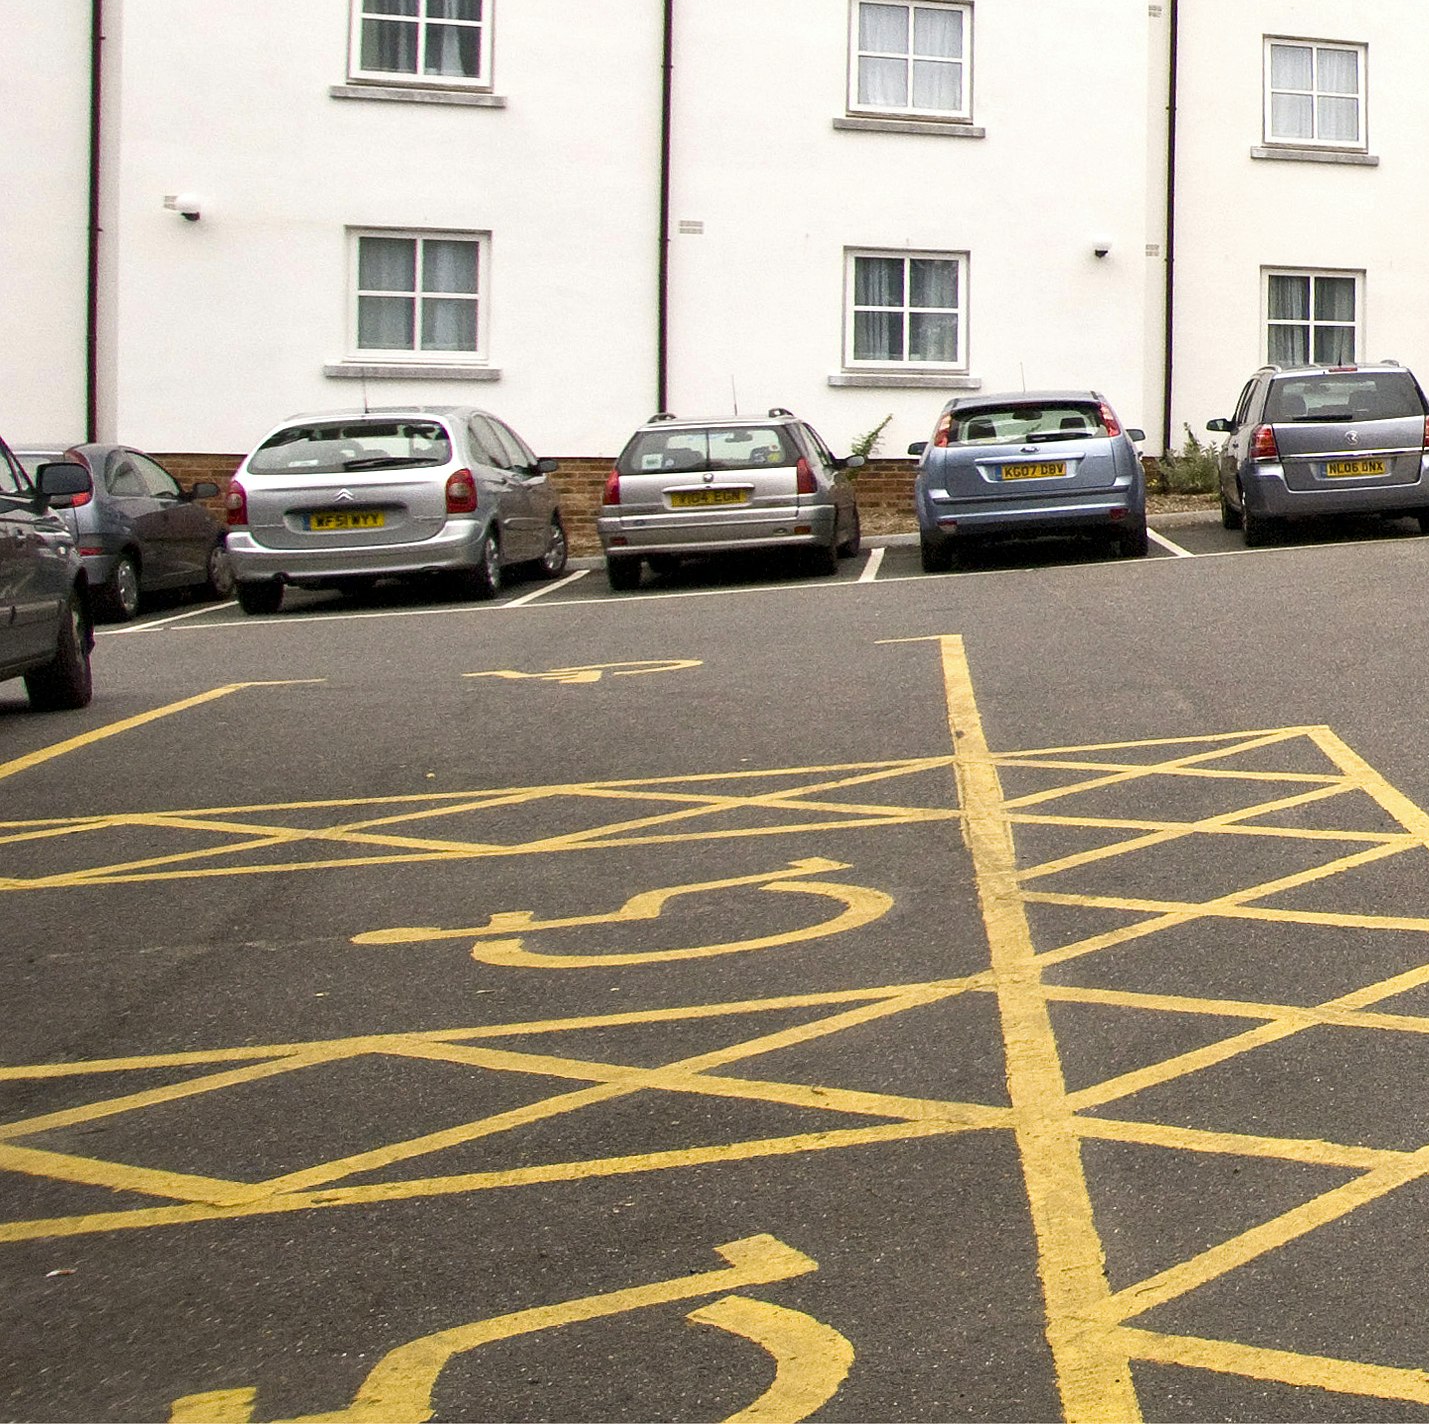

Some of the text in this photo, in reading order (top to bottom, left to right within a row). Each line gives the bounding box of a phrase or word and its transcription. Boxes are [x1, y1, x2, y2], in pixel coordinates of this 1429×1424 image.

[1004, 464, 1038, 477] KG07
[1329, 460, 1383, 474] NL06 DNX
